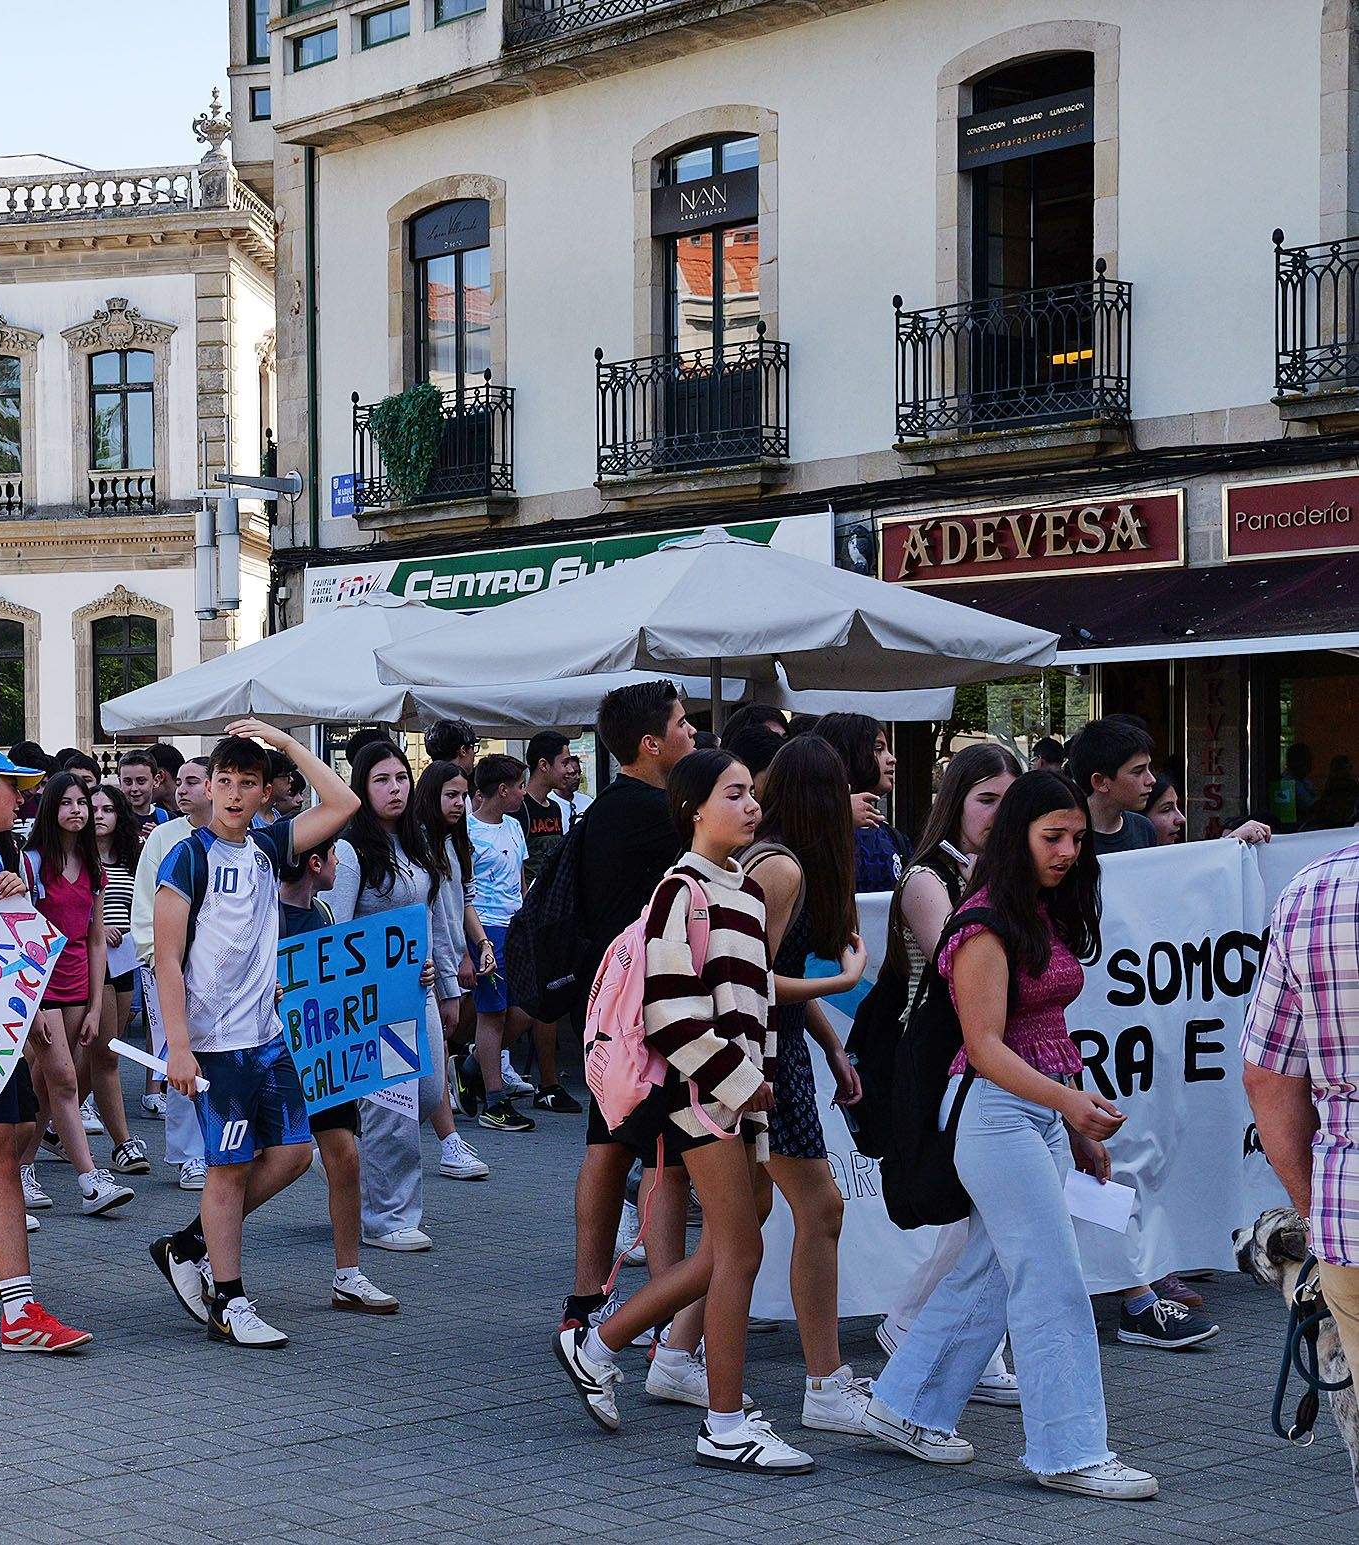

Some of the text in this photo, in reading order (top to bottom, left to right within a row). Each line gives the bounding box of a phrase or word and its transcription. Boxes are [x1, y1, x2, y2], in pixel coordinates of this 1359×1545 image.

[1235, 500, 1351, 531] Panadería
[404, 566, 545, 601] CENTRO
[213, 866, 239, 893] 10
[277, 930, 367, 993] IES
[219, 1119, 249, 1152] 10
